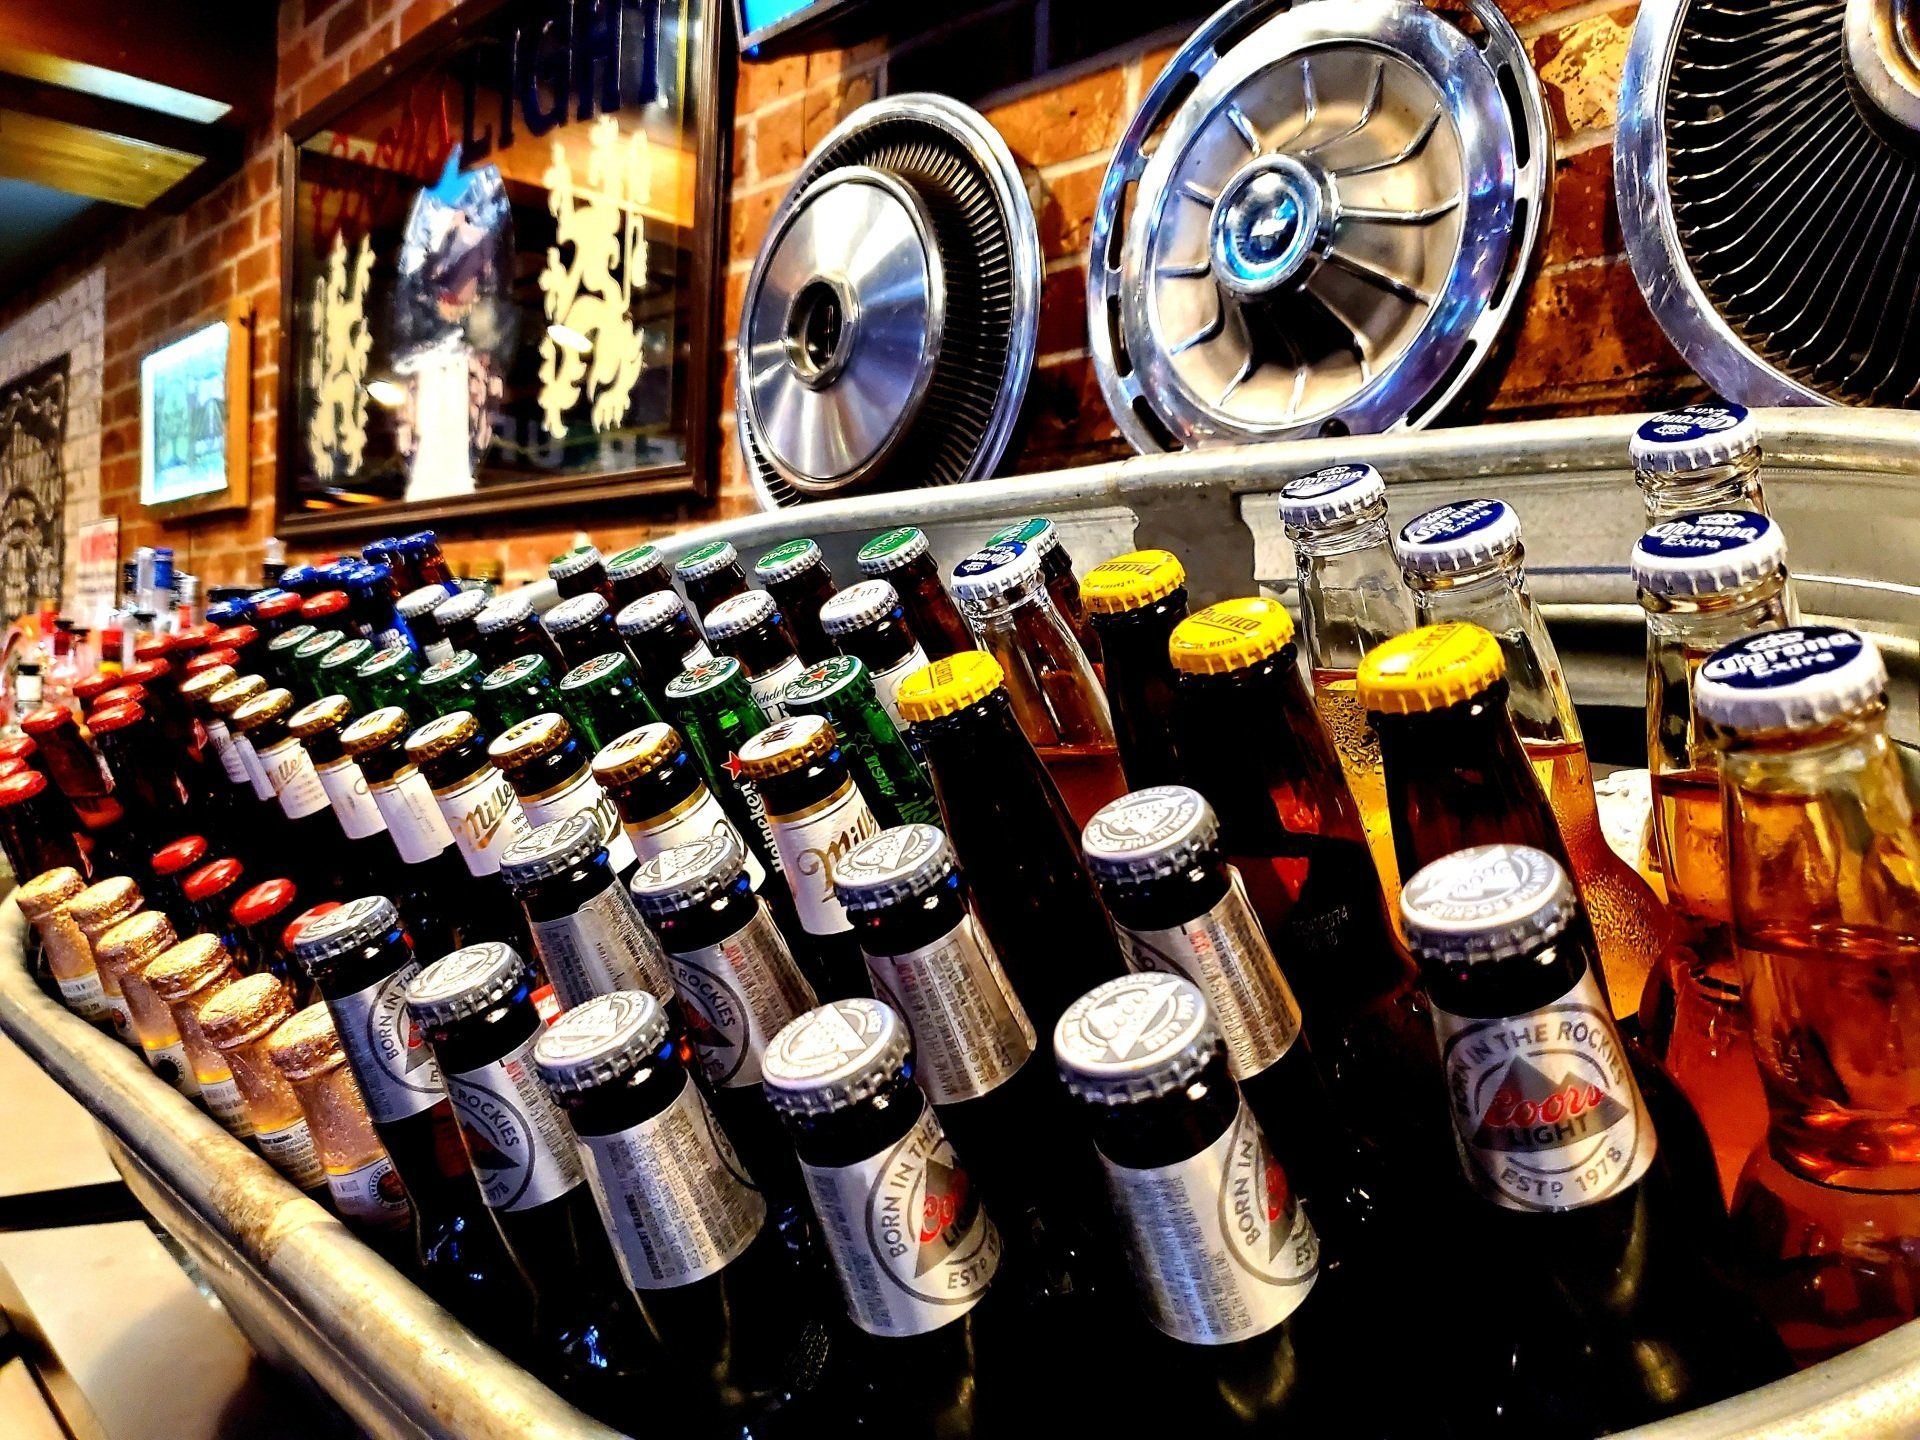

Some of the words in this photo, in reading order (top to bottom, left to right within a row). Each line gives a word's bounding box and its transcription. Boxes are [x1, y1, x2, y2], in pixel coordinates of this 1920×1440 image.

[1286, 469, 1364, 490] Corona
[1409, 500, 1498, 543] Corona
[1646, 521, 1759, 543] Corona
[1661, 535, 1722, 549] Extra
[1092, 563, 1163, 576] PACIFICO
[1198, 607, 1262, 631] PACIFICO
[1703, 632, 1860, 680] Corona
[1750, 651, 1836, 679] Extra
[384, 991, 400, 1011] IN
[678, 967, 737, 1028] ROCKIES
[378, 1016, 400, 1061] BORN
[1466, 1039, 1495, 1065] IN
[1493, 1023, 1549, 1051] THE
[1556, 1020, 1624, 1087] ROCKIES
[457, 1088, 521, 1147] ROCKIES
[1484, 1084, 1605, 1128] Coors
[908, 1114, 941, 1160] THE
[1507, 1112, 1589, 1147] LIGHT
[890, 1161, 915, 1189] IN
[1238, 1139, 1254, 1168] IN
[1575, 1146, 1622, 1192] 1978
[881, 1196, 909, 1258] BORN
[1233, 1176, 1262, 1247] BORN
